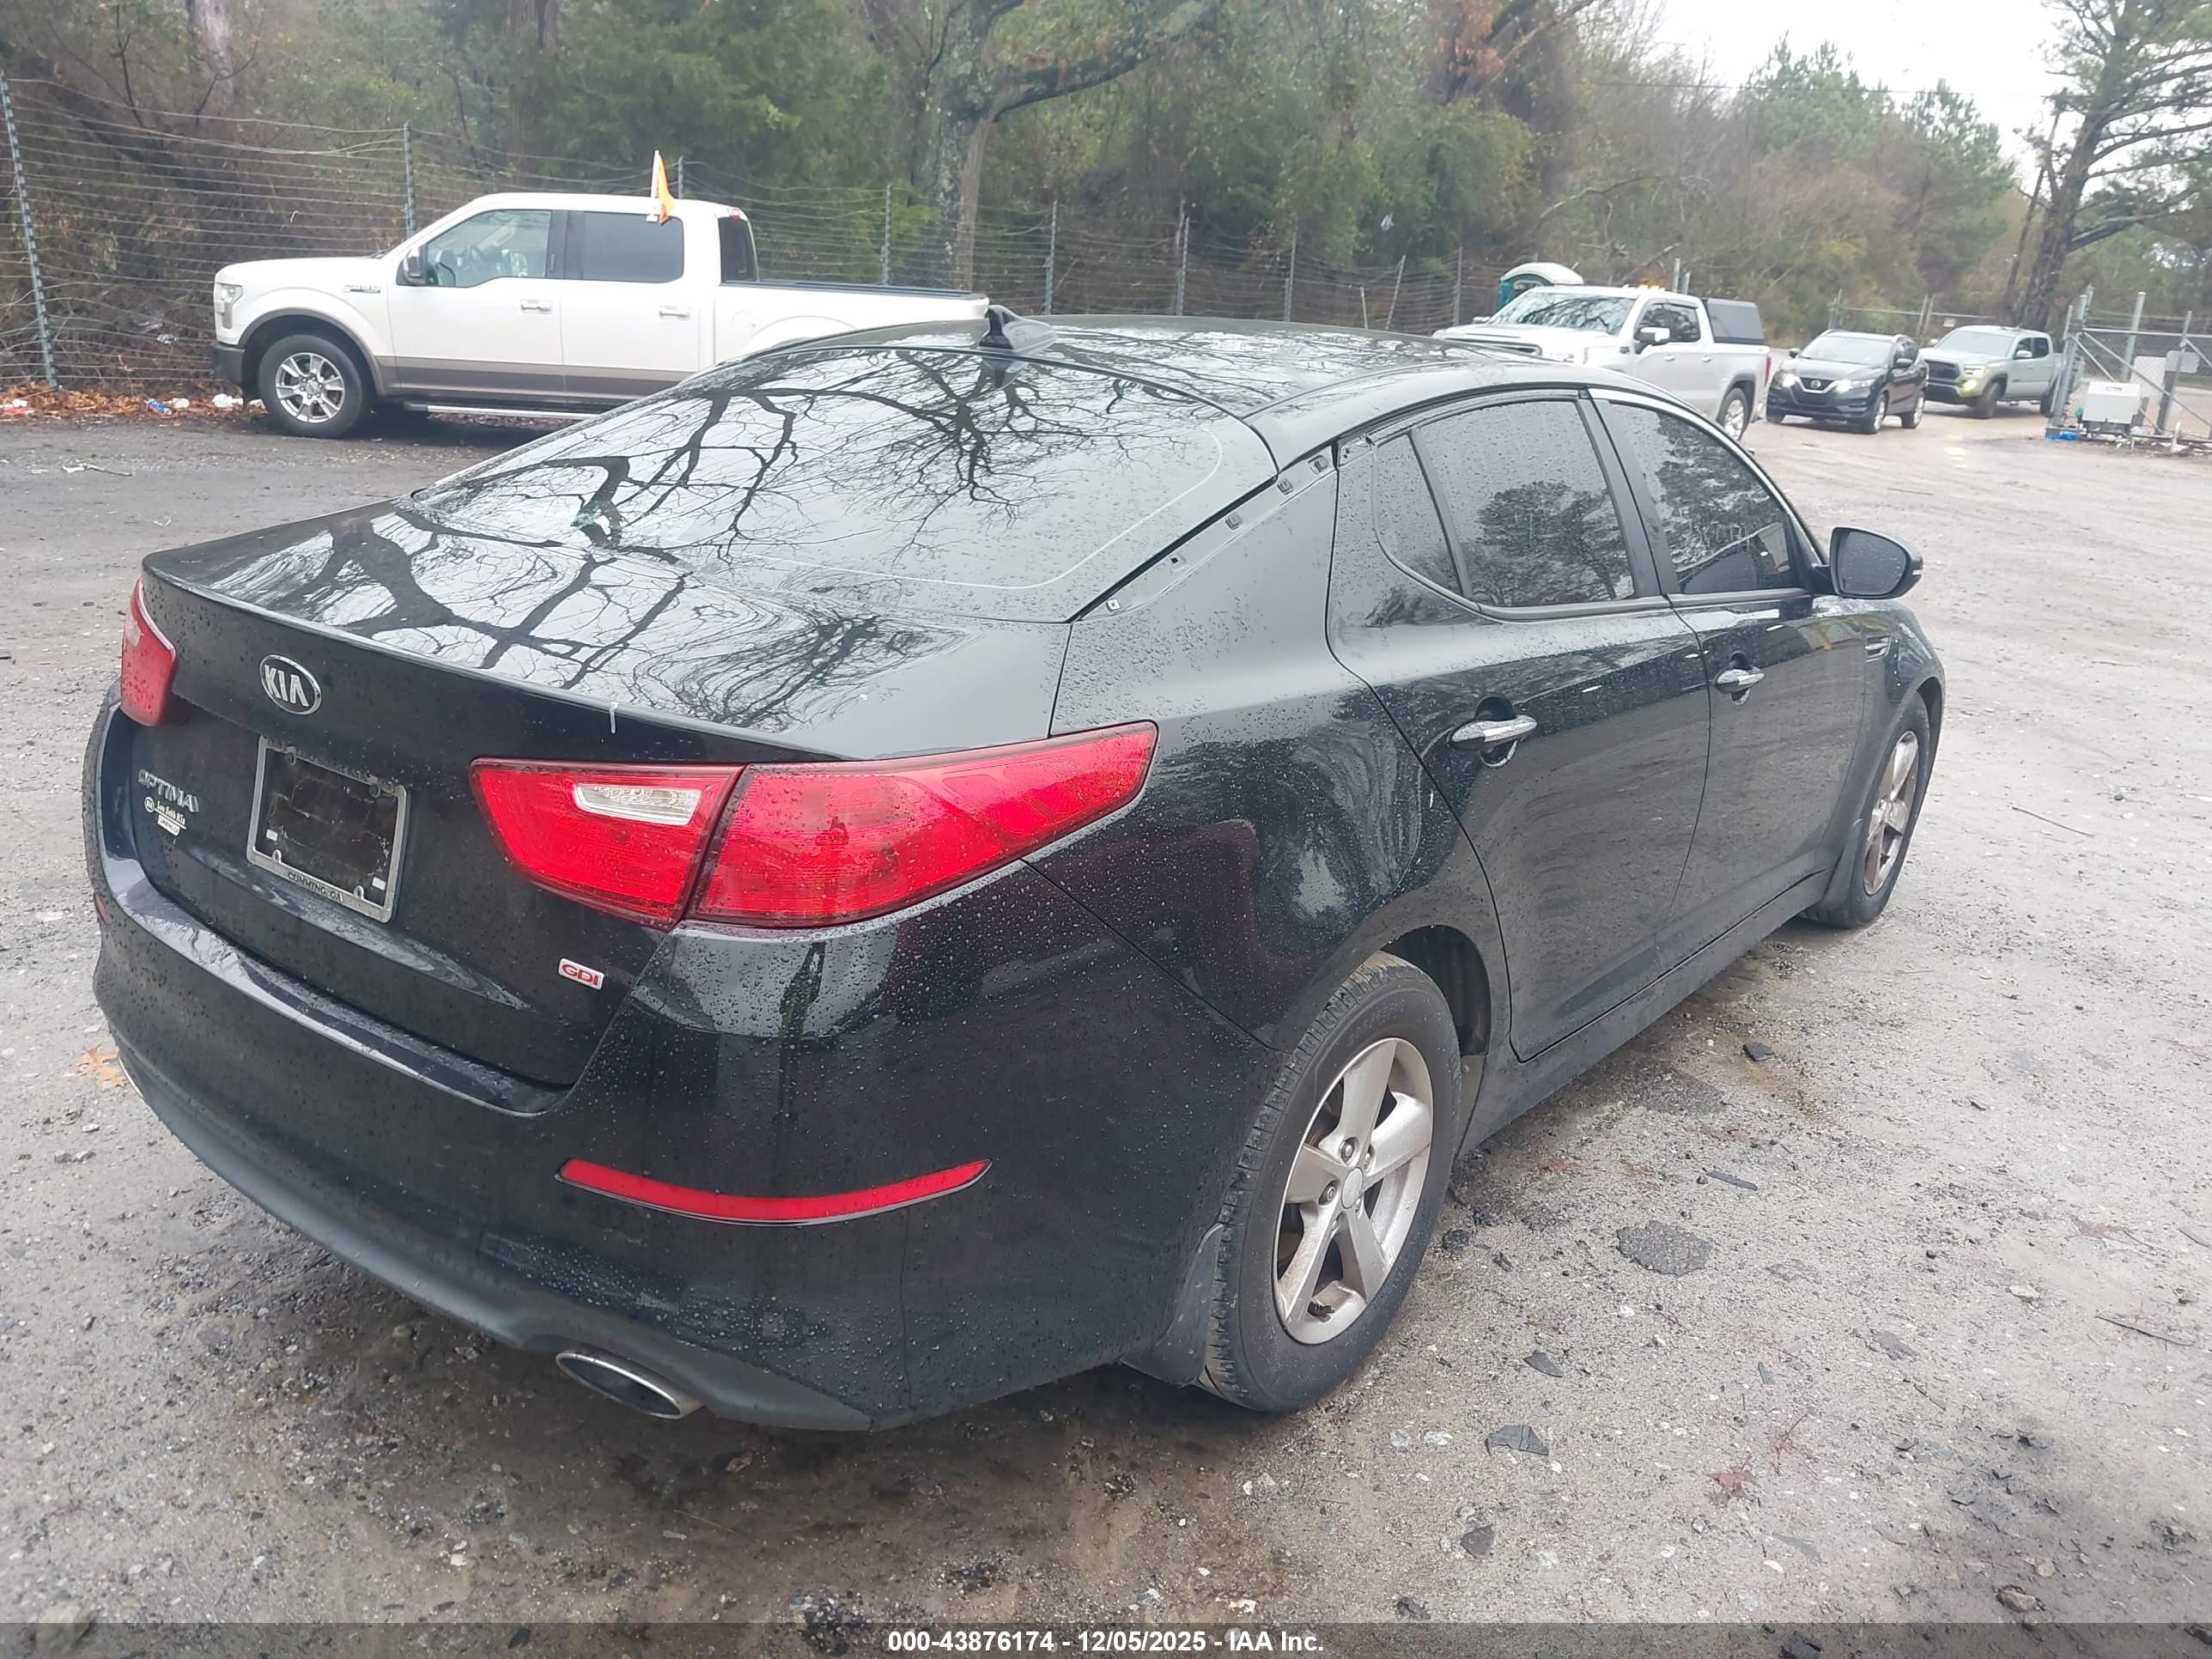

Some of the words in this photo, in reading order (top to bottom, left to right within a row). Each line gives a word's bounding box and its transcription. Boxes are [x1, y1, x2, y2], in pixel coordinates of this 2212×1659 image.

[264, 664, 309, 708] KIA
[138, 769, 199, 813] OPTIMA
[331, 890, 343, 902] GA
[562, 963, 599, 986] GDI
